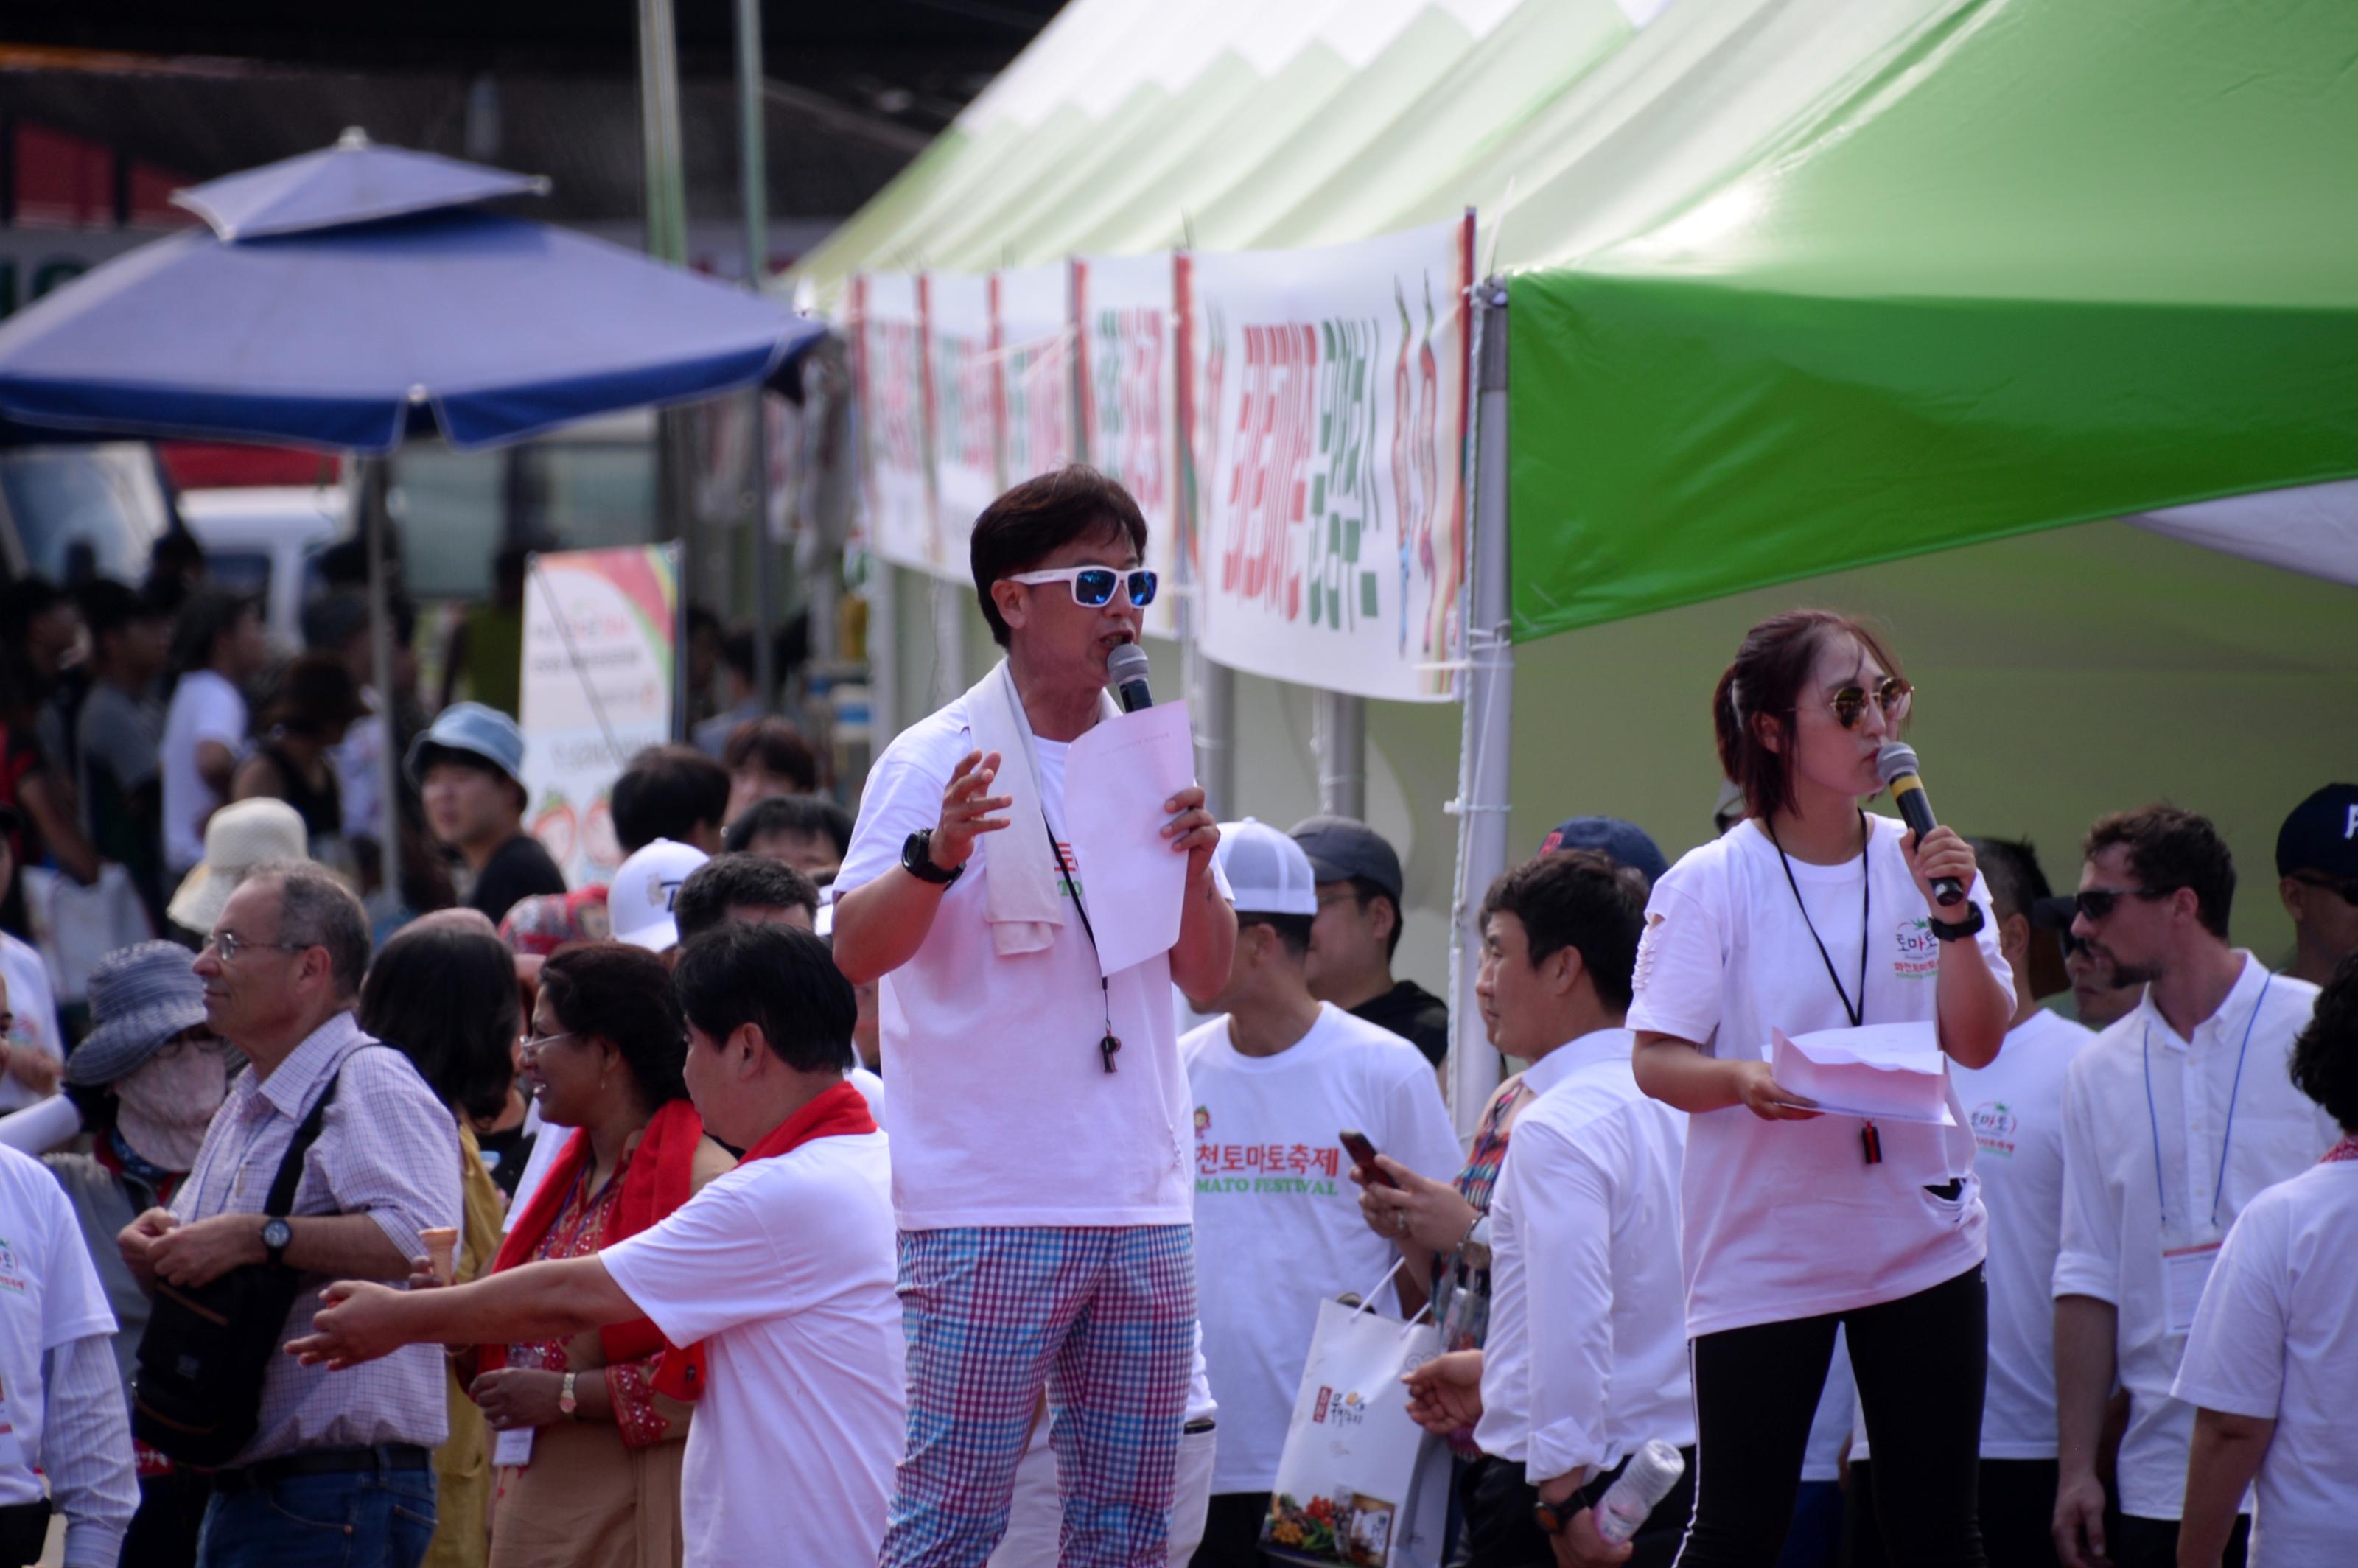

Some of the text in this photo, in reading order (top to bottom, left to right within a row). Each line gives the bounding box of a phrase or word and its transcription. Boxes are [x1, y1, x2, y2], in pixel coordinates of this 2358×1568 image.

[1896, 930, 1938, 952] 토마토
[1894, 959, 1939, 973] 화천토마토
[1195, 1144, 1340, 1177] 천토마토축제
[1254, 1177, 1338, 1195] FESTIVAL
